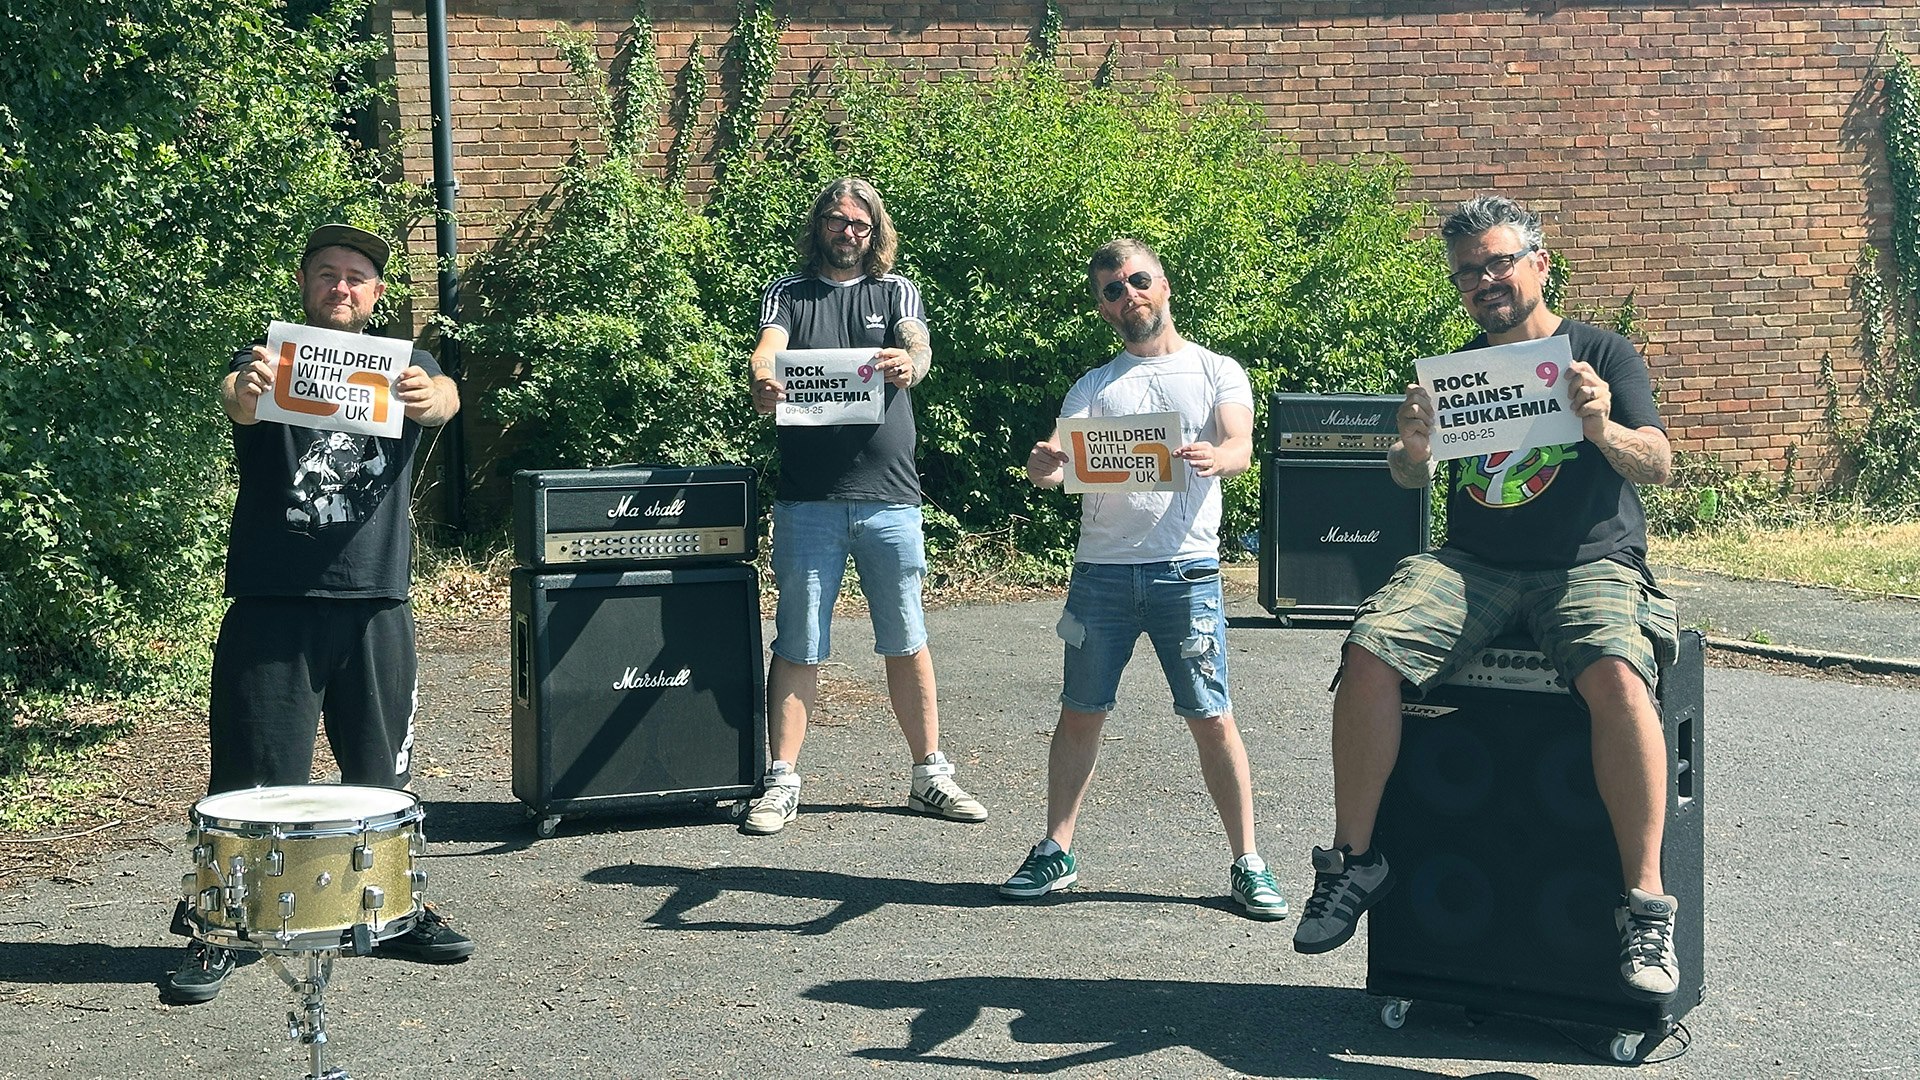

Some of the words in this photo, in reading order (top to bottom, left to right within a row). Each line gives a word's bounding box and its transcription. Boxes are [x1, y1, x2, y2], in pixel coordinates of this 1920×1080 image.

[300, 345, 392, 371] CHILDREN
[297, 362, 342, 382] WITH
[785, 365, 825, 377] ROCK
[785, 378, 848, 390] AGAINST
[1432, 371, 1489, 392] ROCK
[294, 380, 371, 403] CANCER
[785, 391, 871, 403] LEUKAEMIA
[1438, 384, 1524, 411] AGAINST
[345, 405, 369, 421] UK
[1321, 410, 1380, 426] Marshall
[1439, 398, 1562, 429] LEUKAEMIA
[1087, 428, 1167, 442] CHILDREN
[1442, 428, 1495, 444] 09-08-25
[1089, 443, 1127, 455] WITH
[1090, 456, 1155, 470] CANCER
[1136, 471, 1156, 483] UK
[1320, 526, 1380, 543] Marshall
[612, 666, 691, 690] Marshall
